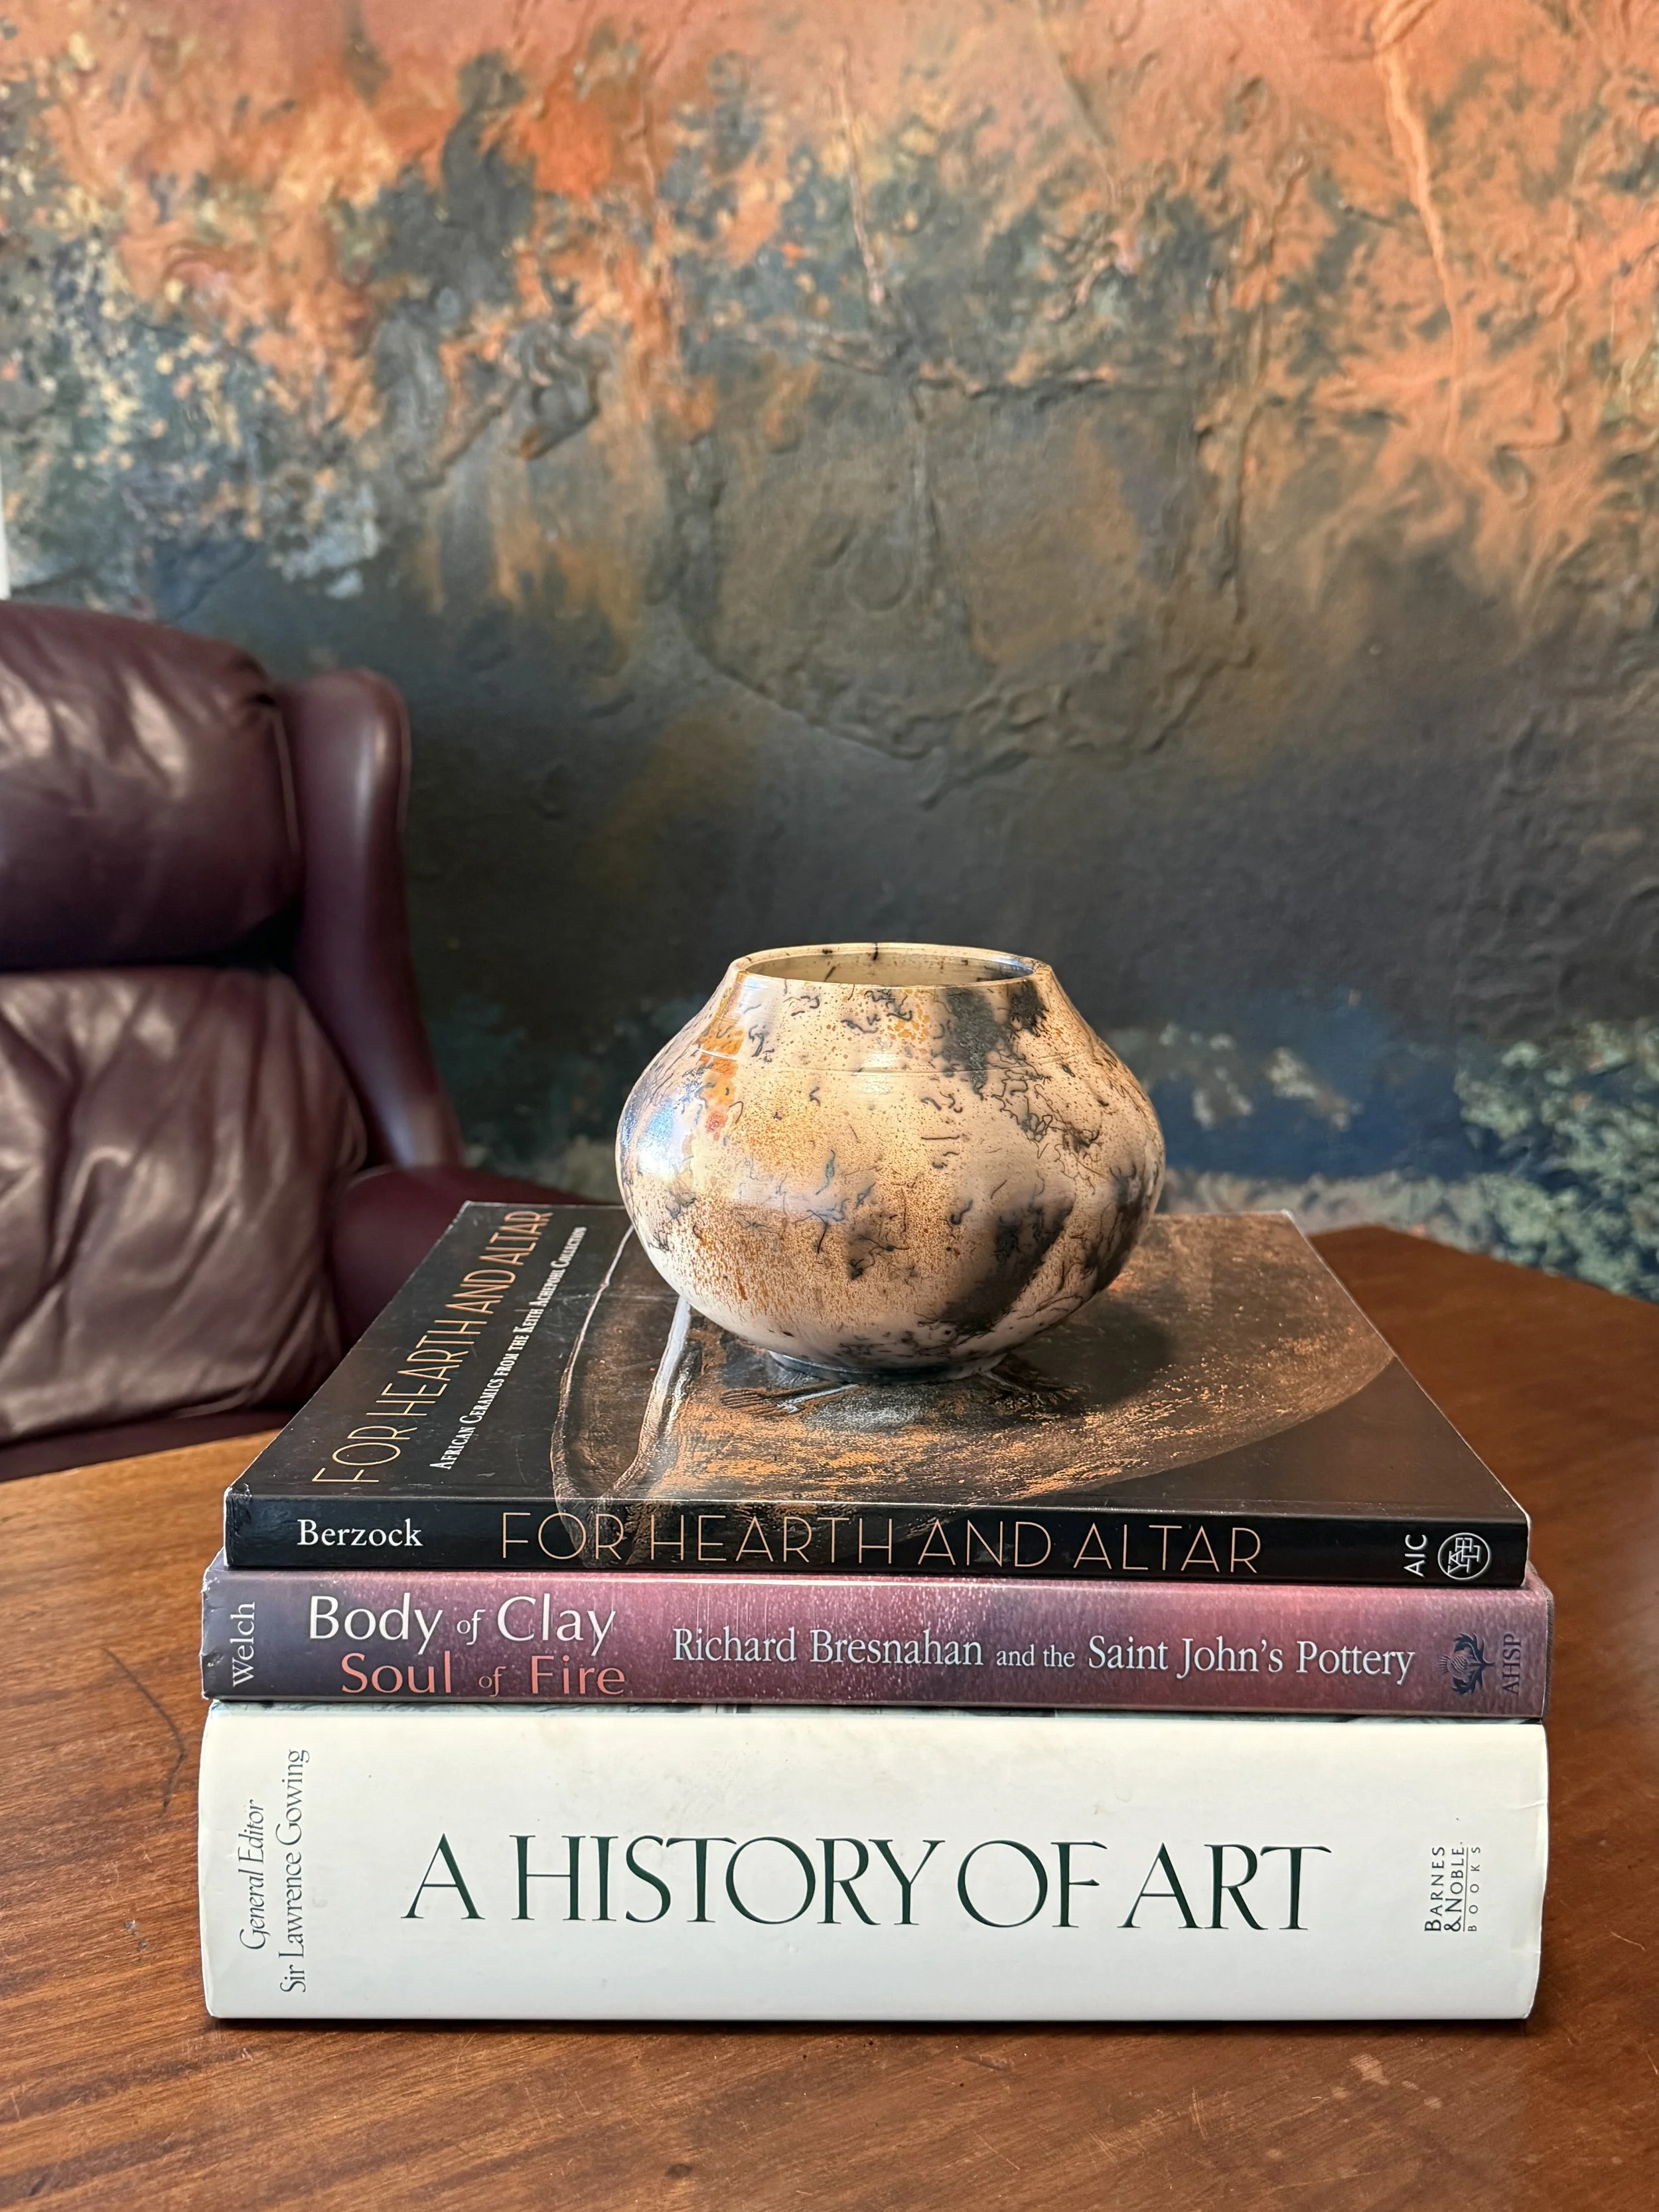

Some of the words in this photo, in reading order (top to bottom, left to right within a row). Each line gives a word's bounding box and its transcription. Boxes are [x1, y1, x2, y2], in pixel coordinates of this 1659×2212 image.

[479, 1211, 553, 1266] ALTAR
[446, 1269, 516, 1314] AND
[512, 1308, 544, 1333] KEITH
[366, 1319, 487, 1416] HEARTH
[493, 1353, 520, 1377] FROM
[508, 1334, 530, 1351] THE
[459, 1378, 505, 1424] CERAMICS
[312, 1426, 417, 1483] FOR
[429, 1426, 476, 1469] AFRICAN
[297, 1518, 424, 1547] Berzock
[501, 1512, 624, 1562] FOR
[650, 1514, 893, 1564] HEARTH
[917, 1518, 1052, 1568] AND
[1073, 1522, 1262, 1574] ALTAR
[1404, 1534, 1427, 1578] AIC
[231, 1601, 255, 1687] Welch
[309, 1593, 443, 1655] Body
[457, 1609, 486, 1645] of
[496, 1593, 616, 1657] Clay
[340, 1651, 451, 1694] Soul
[478, 1666, 506, 1697] of
[531, 1655, 626, 1695] Fire
[673, 1626, 797, 1662] Richard
[810, 1629, 984, 1666] Bresnahan
[996, 1644, 1035, 1667] and
[1043, 1645, 1075, 1668] the
[1088, 1634, 1169, 1671] Saint
[1176, 1636, 1283, 1679] John’s
[1296, 1641, 1415, 1686] Pottery
[1501, 1633, 1522, 1695] AHSP
[275, 1749, 311, 1846] Gowing
[238, 1799, 265, 1866] Editor
[239, 1868, 271, 1951] General
[277, 1852, 305, 1958] Lawrence
[400, 1832, 486, 1920] A
[509, 1834, 946, 1925] HISTORY
[957, 1839, 1108, 1928] OF
[1117, 1842, 1333, 1931] ART
[1423, 1846, 1445, 1932] BARNES
[1467, 1846, 1481, 1931] BOOKS
[279, 1964, 307, 1993] Sir
